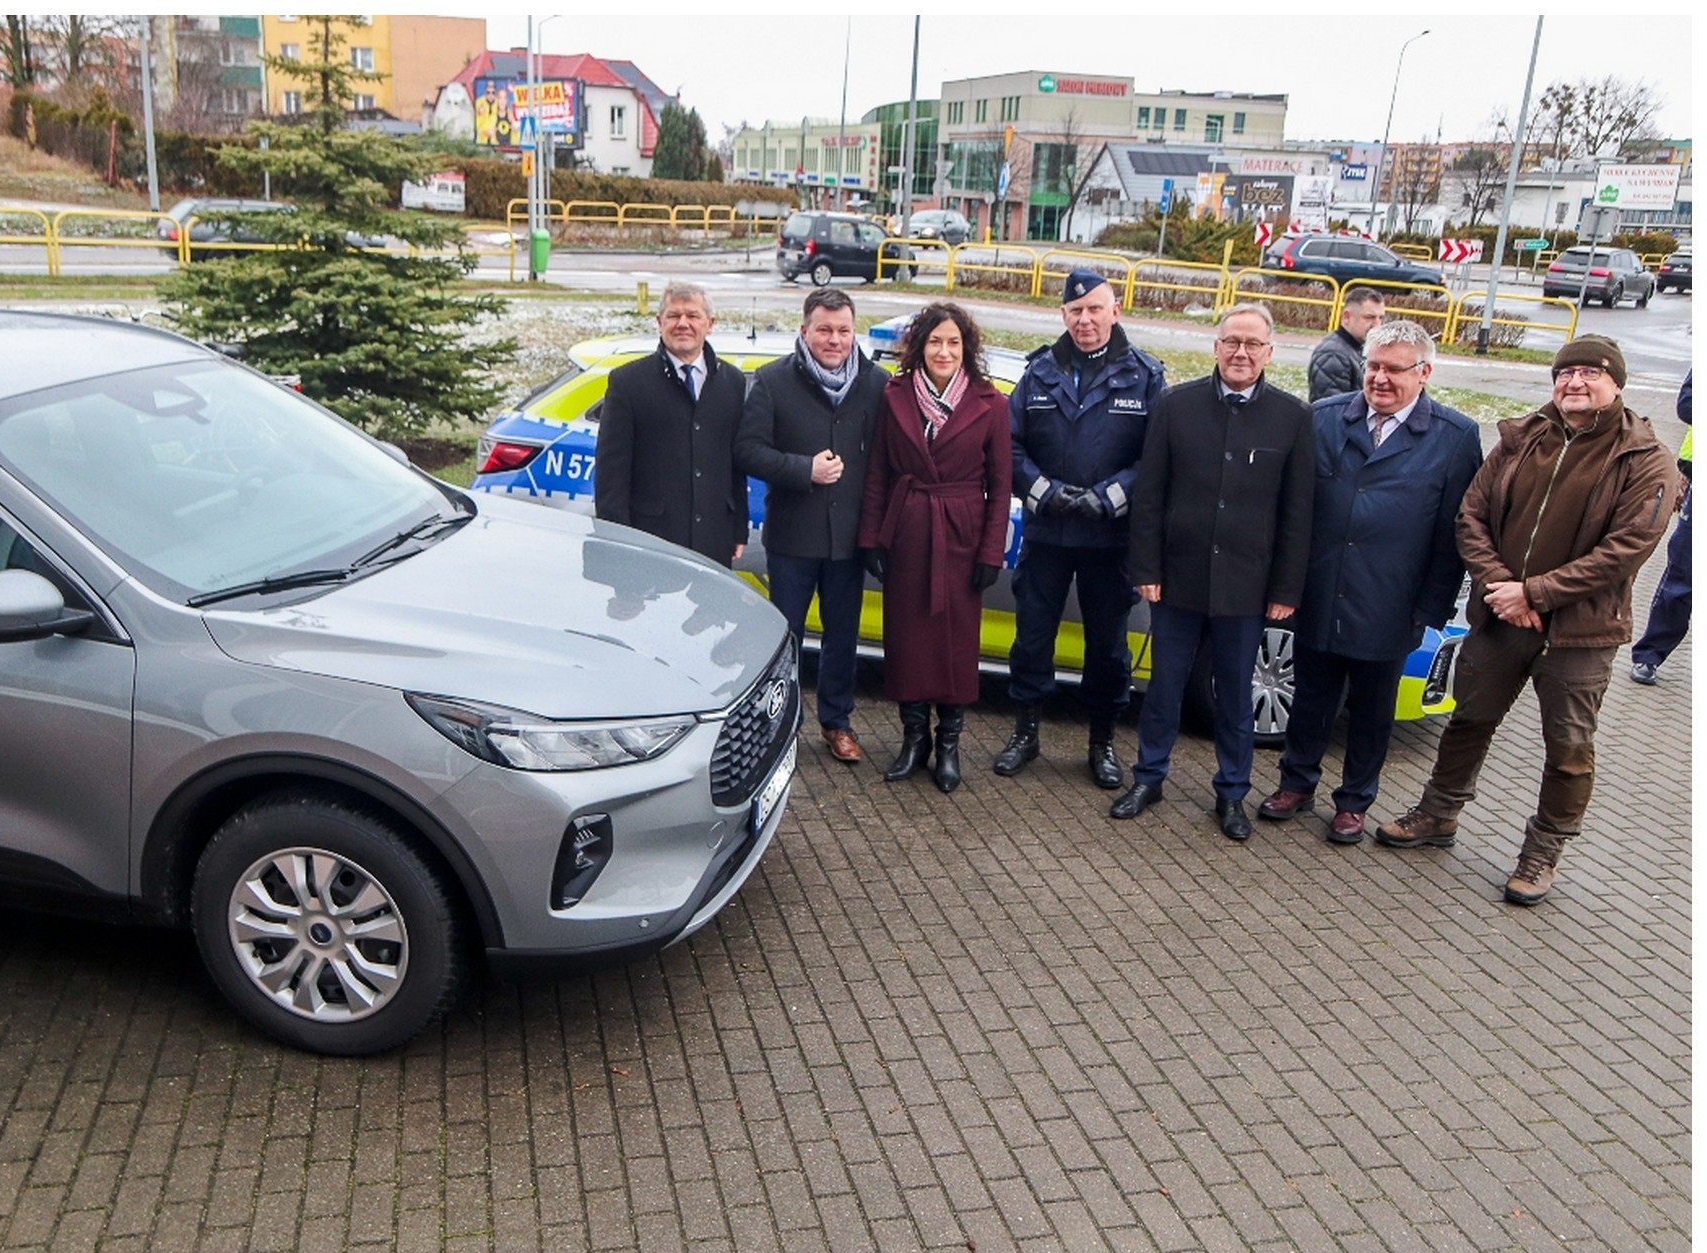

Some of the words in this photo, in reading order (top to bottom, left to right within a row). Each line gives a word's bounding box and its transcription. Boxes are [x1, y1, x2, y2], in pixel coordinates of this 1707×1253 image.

[1243, 160, 1303, 173] MATERACE
[1241, 183, 1285, 206] bez
[1114, 399, 1142, 409] POLICJA
[545, 449, 564, 476] N
